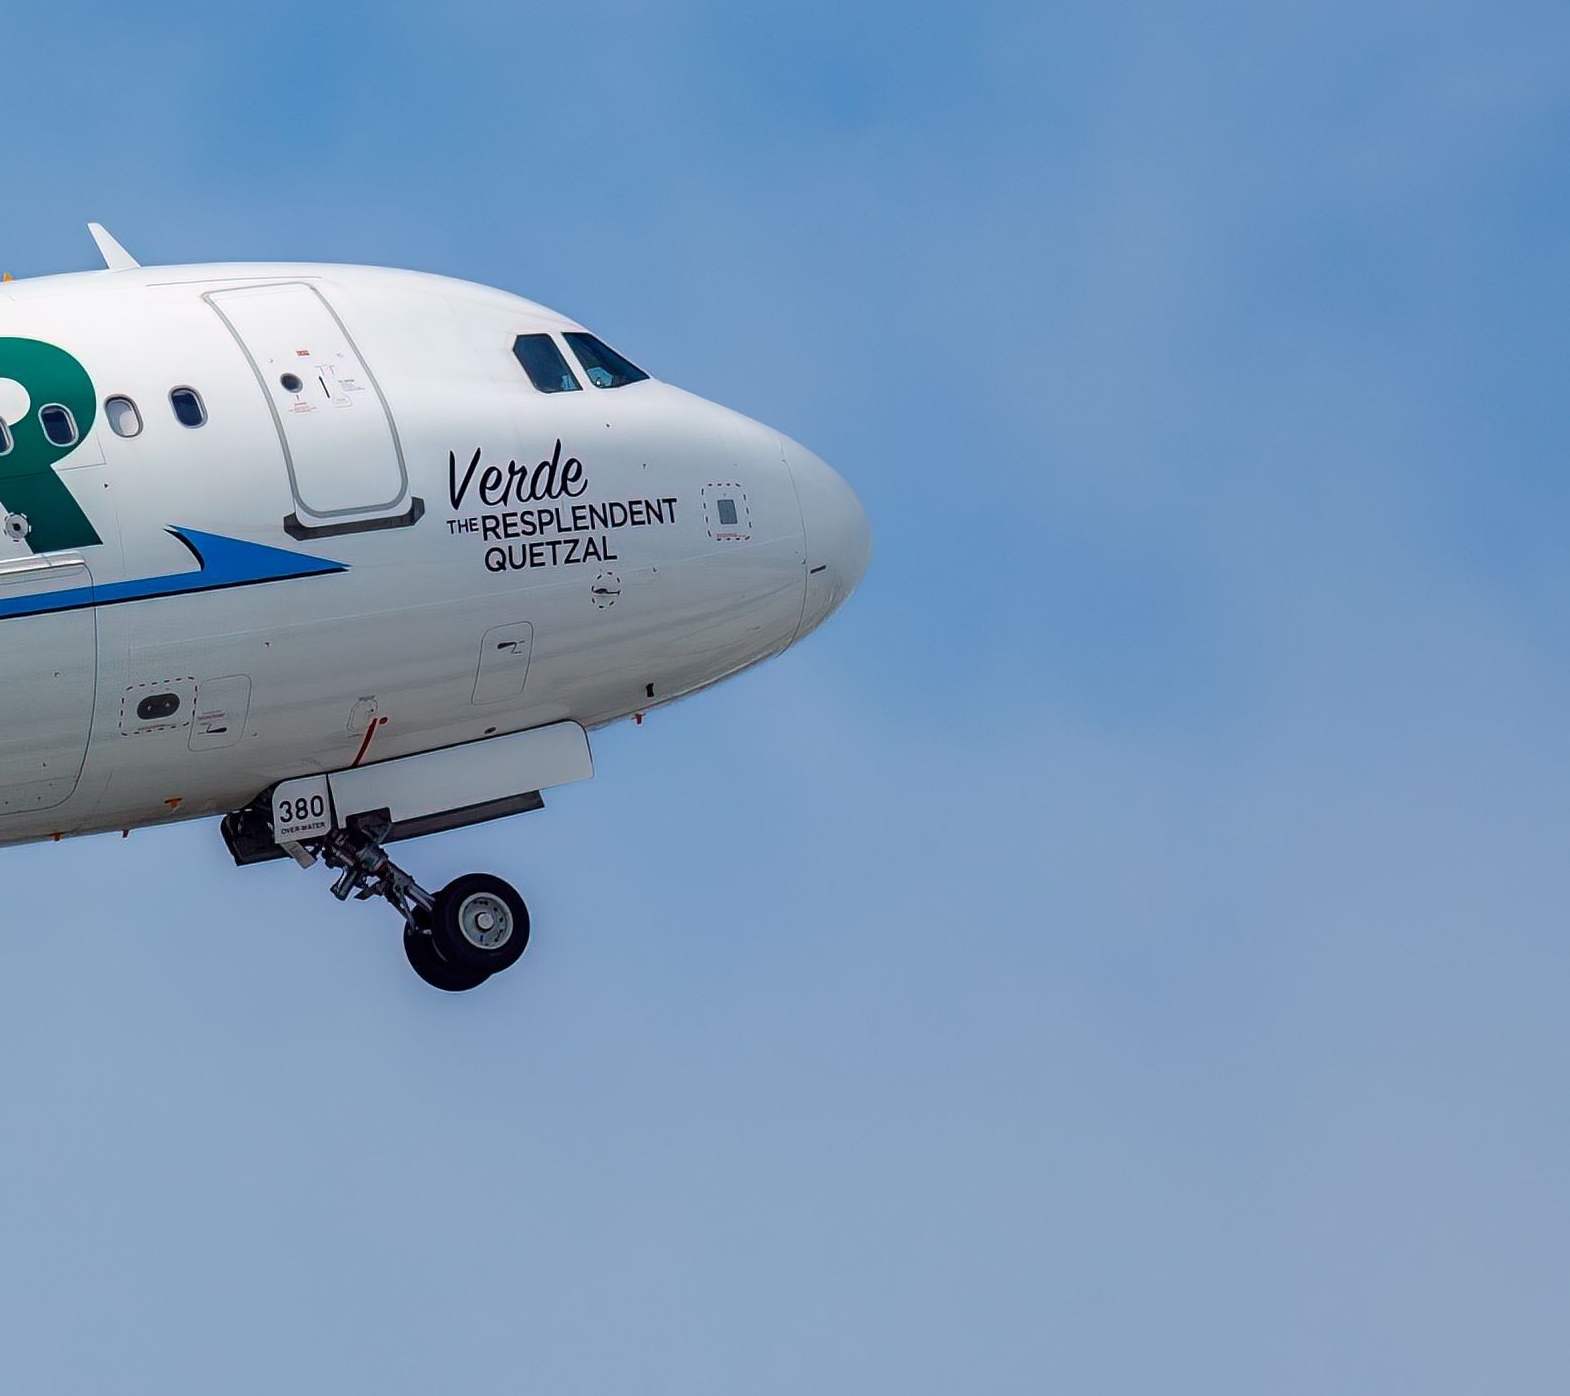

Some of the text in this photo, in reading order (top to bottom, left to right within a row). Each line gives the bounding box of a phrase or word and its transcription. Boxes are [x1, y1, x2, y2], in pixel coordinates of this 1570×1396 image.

[448, 438, 589, 511] Verde
[446, 497, 678, 542] THE RESPLENDENT
[484, 535, 618, 573] QUETZAL
[278, 794, 325, 824] 380
